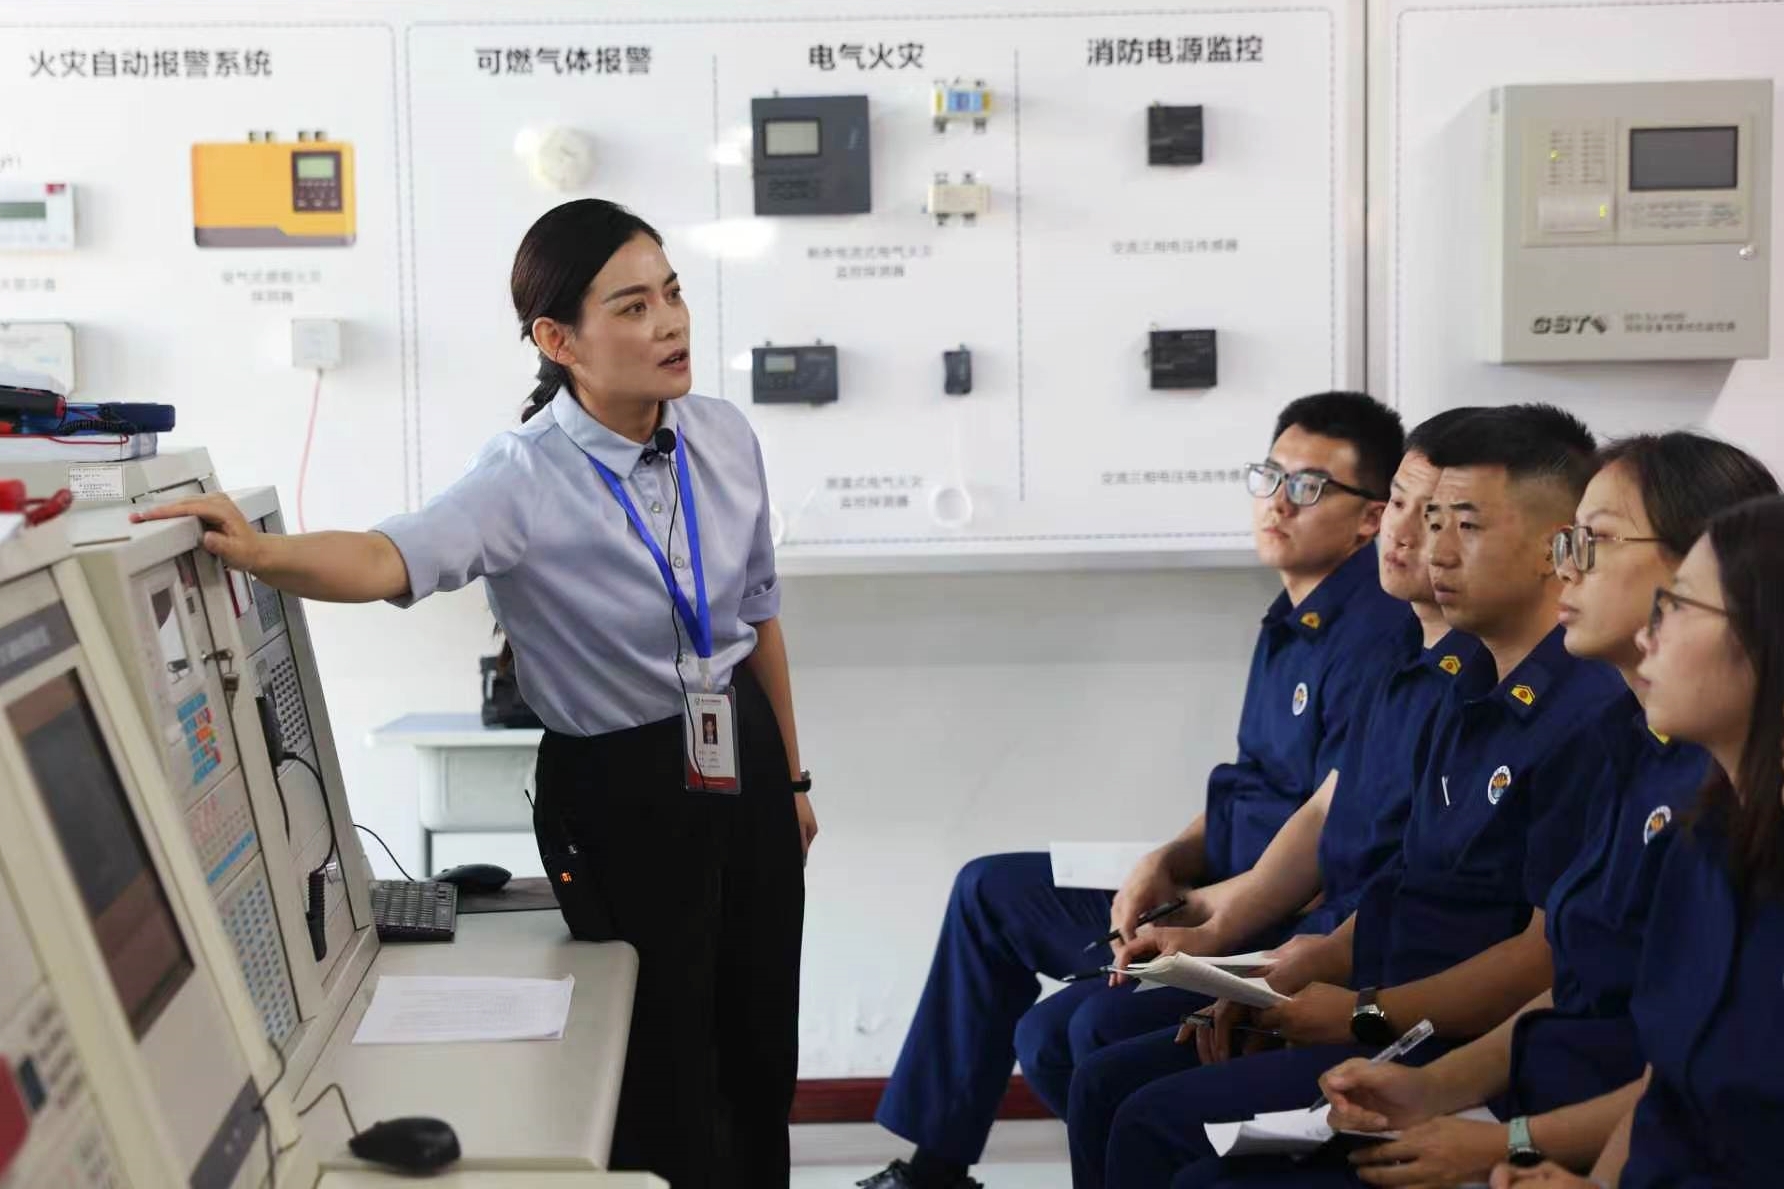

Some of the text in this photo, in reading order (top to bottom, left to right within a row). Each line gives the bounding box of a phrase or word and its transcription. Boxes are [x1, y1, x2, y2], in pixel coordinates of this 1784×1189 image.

[29, 49, 272, 78] 火灾自动报警系统
[475, 46, 652, 75] 可燃气体报警
[808, 42, 924, 71] 电气火灾
[1087, 35, 1263, 66] 消防电源监控
[1531, 315, 1592, 335] GST
